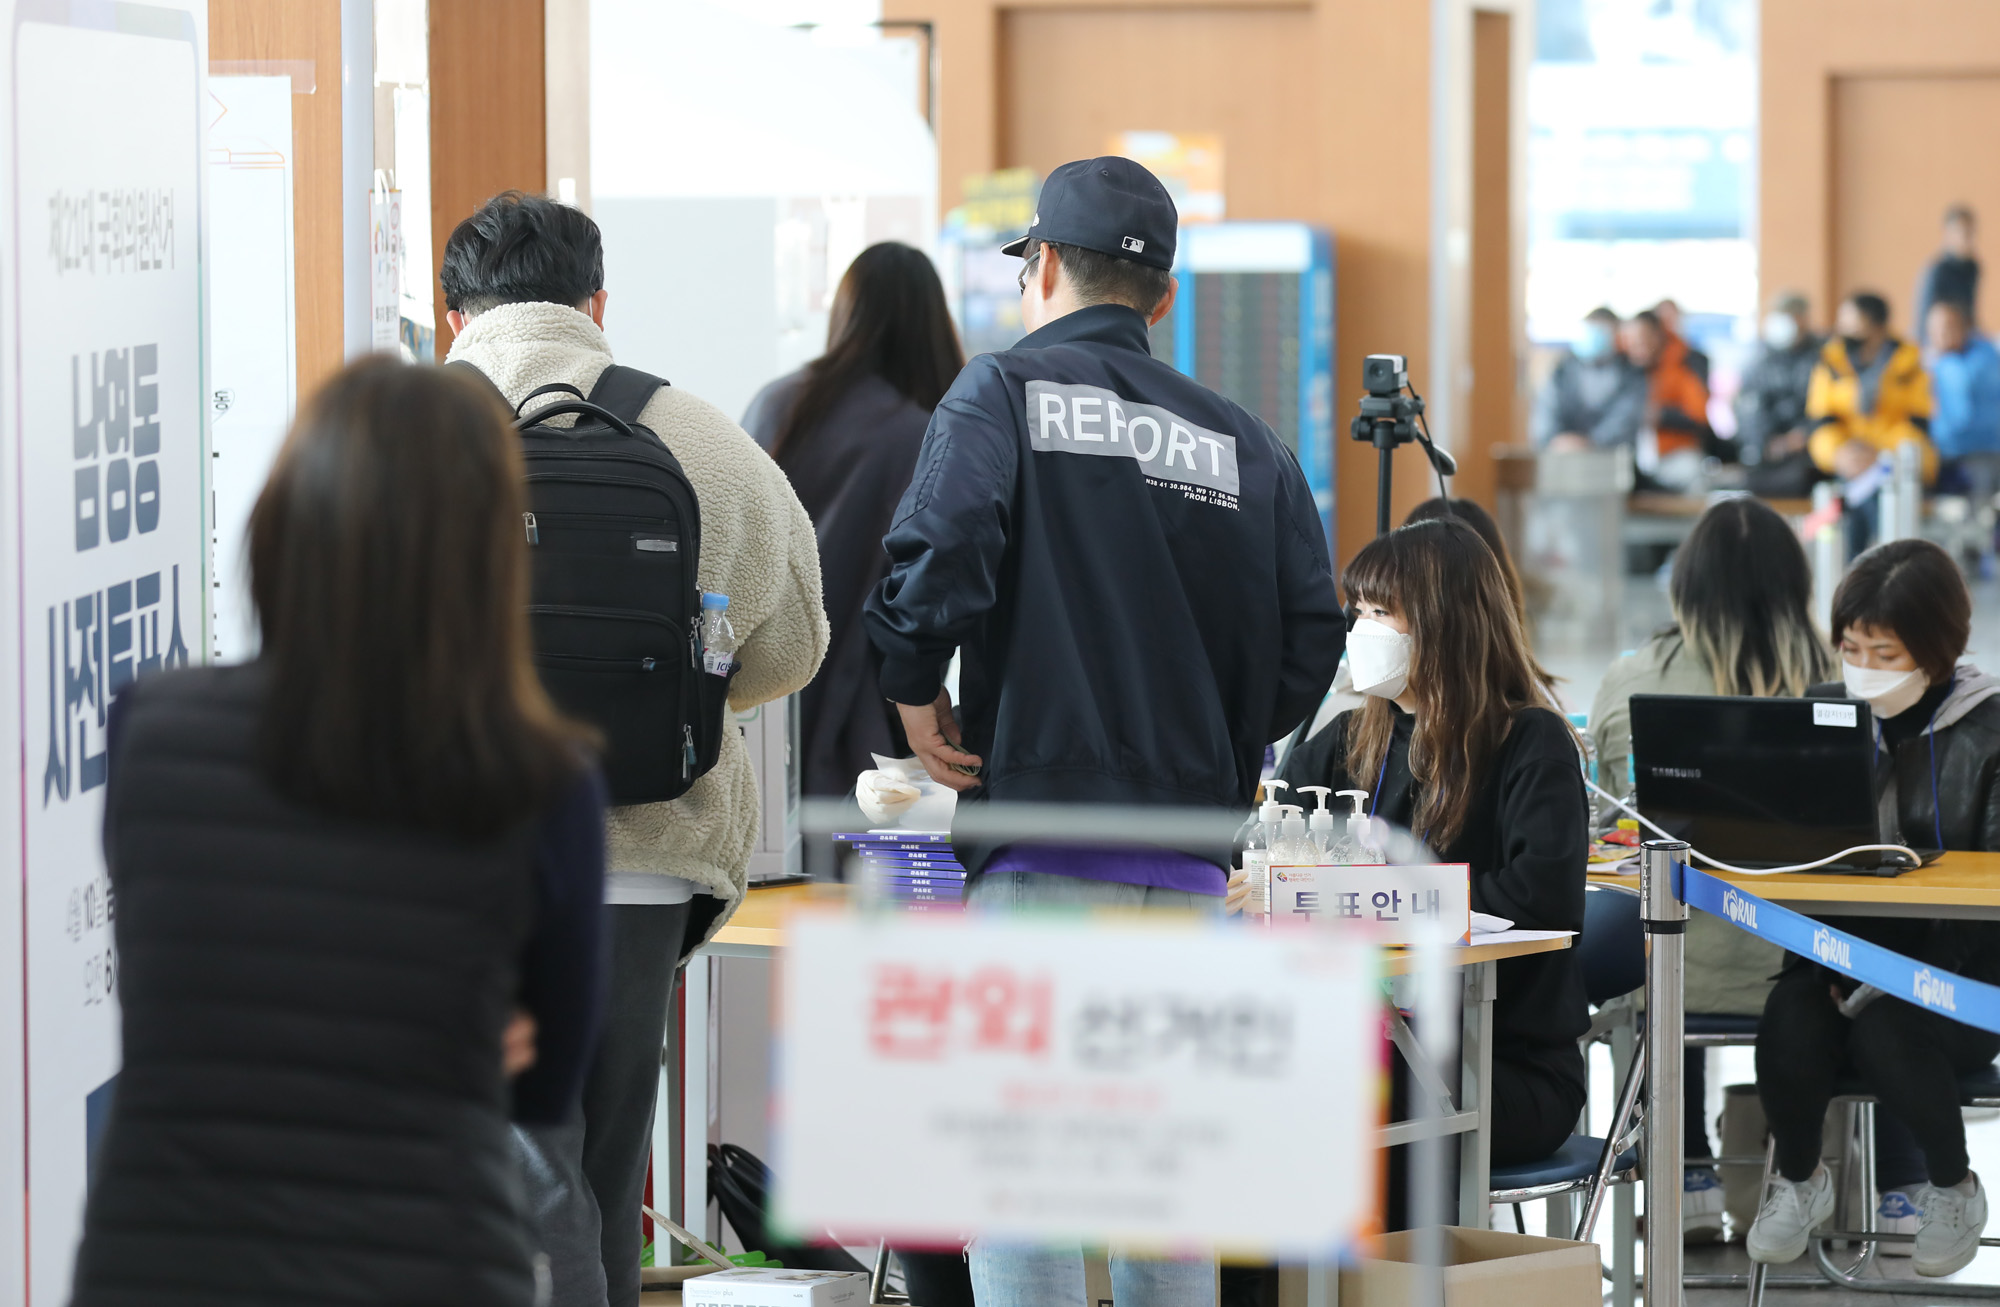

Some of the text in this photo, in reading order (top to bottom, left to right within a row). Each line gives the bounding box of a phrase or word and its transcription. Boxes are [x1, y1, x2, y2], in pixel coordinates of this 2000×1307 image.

[98, 187, 174, 275] 국회의원선거
[72, 342, 160, 553] 남영동
[1038, 392, 1226, 478] REPORT
[1184, 491, 1240, 512] FROM LISBON,
[1196, 487, 1207, 495] W9
[1651, 766, 1702, 778] SAMSUNG
[1722, 889, 1758, 929] KORAIL
[1812, 927, 1852, 969] KORAIL
[1912, 968, 1956, 1013] KORAIL
